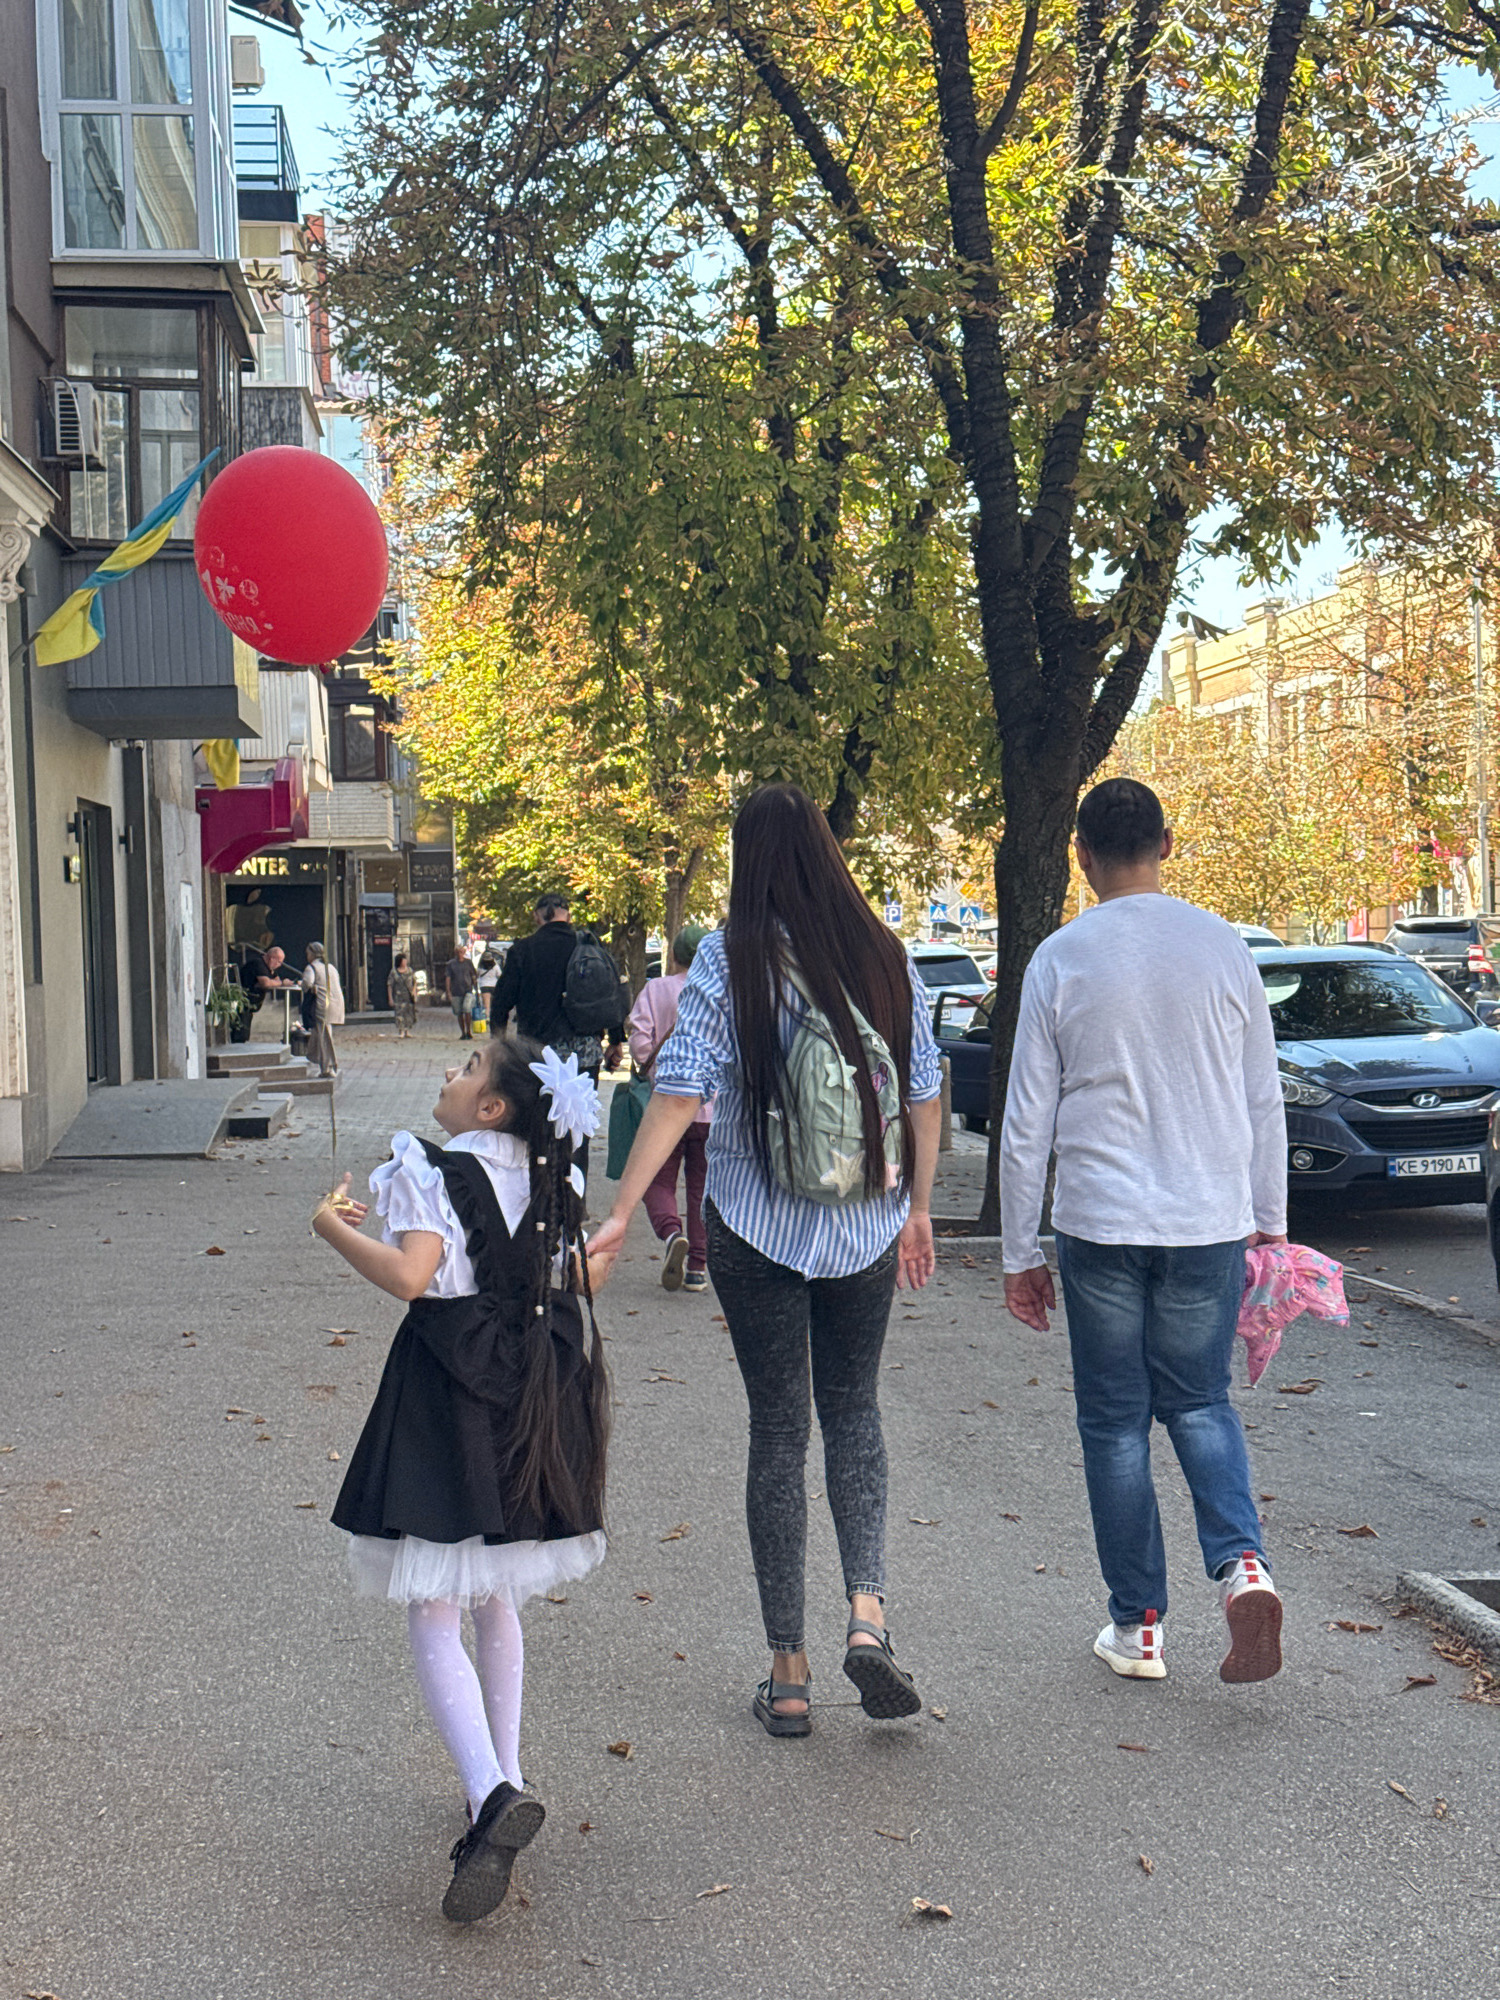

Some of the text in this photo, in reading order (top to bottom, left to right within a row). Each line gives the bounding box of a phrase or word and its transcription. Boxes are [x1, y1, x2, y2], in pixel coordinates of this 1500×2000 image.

[889, 908, 899, 922] P
[1397, 1157, 1477, 1174] KE 9190 AT
